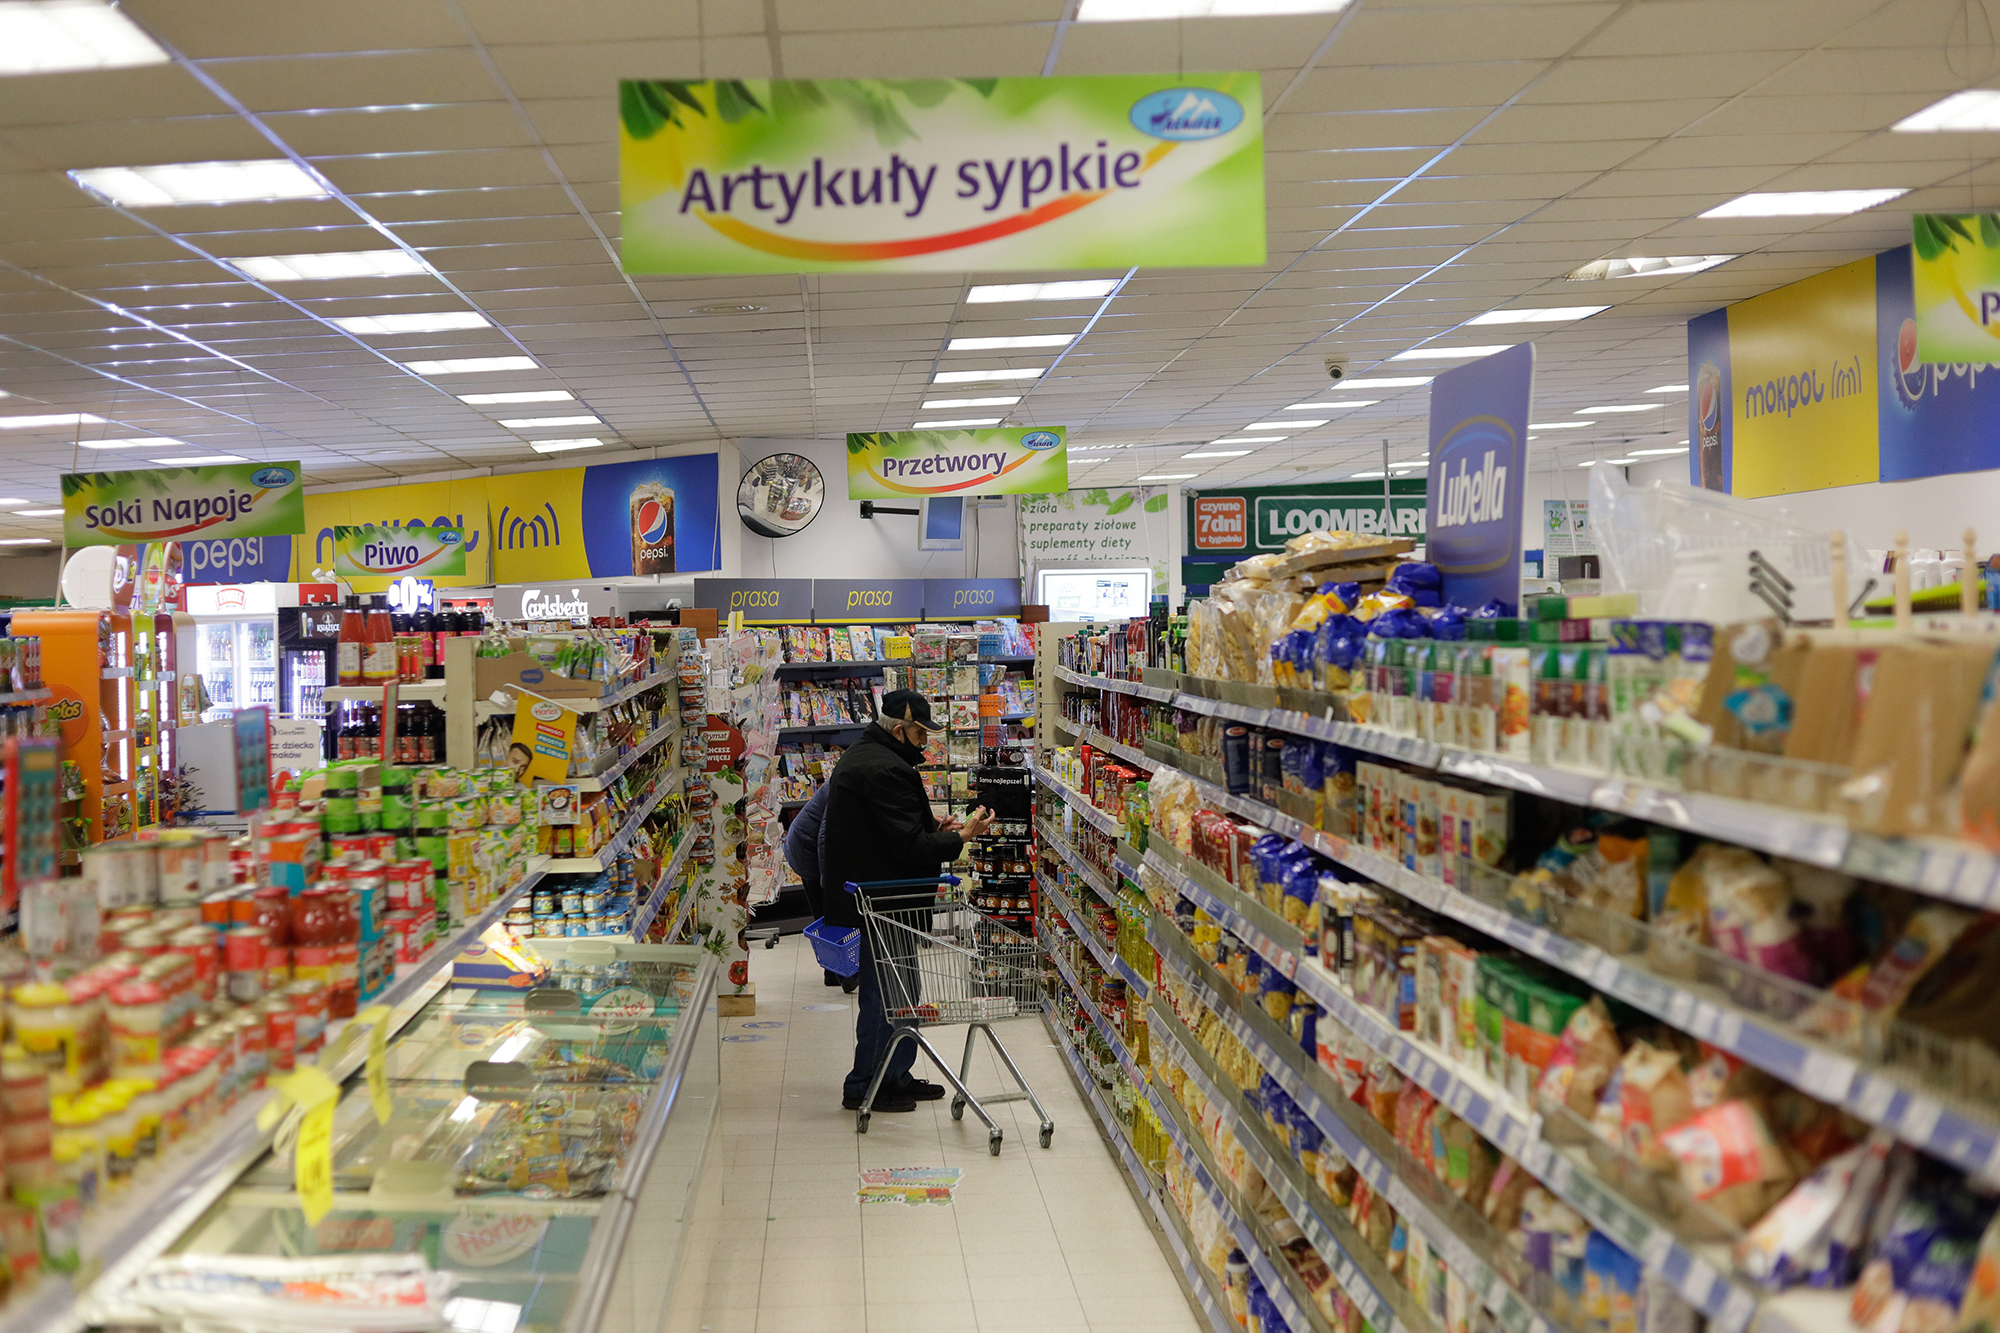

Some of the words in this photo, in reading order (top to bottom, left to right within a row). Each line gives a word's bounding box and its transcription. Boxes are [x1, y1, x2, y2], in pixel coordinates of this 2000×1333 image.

[679, 154, 938, 224] Artykuły
[956, 140, 1142, 212] sypkie
[883, 451, 1007, 477] Przetwory
[1436, 449, 1507, 528] Lubella
[84, 499, 142, 529] Soki
[152, 488, 253, 524] Napoje
[1030, 502, 1057, 514] zioła
[1199, 501, 1241, 513] czynne
[1030, 521, 1089, 534] preparaty
[1094, 519, 1137, 531] ziołowe
[1030, 538, 1096, 552] suplementy
[1101, 536, 1132, 550] diety
[1208, 534, 1243, 545] tygodniu
[189, 536, 264, 579] pepsi
[364, 541, 419, 566] Piwo
[640, 545, 669, 562] pepsi
[521, 588, 589, 620] Carlsberg
[730, 590, 780, 611] prasa
[846, 589, 893, 611] prasa
[953, 588, 995, 610] prasa
[282, 741, 314, 750] dziecko
[538, 734, 564, 747] PROSTO
[979, 776, 992, 784] Samo
[993, 777, 1023, 786] najlepsze!
